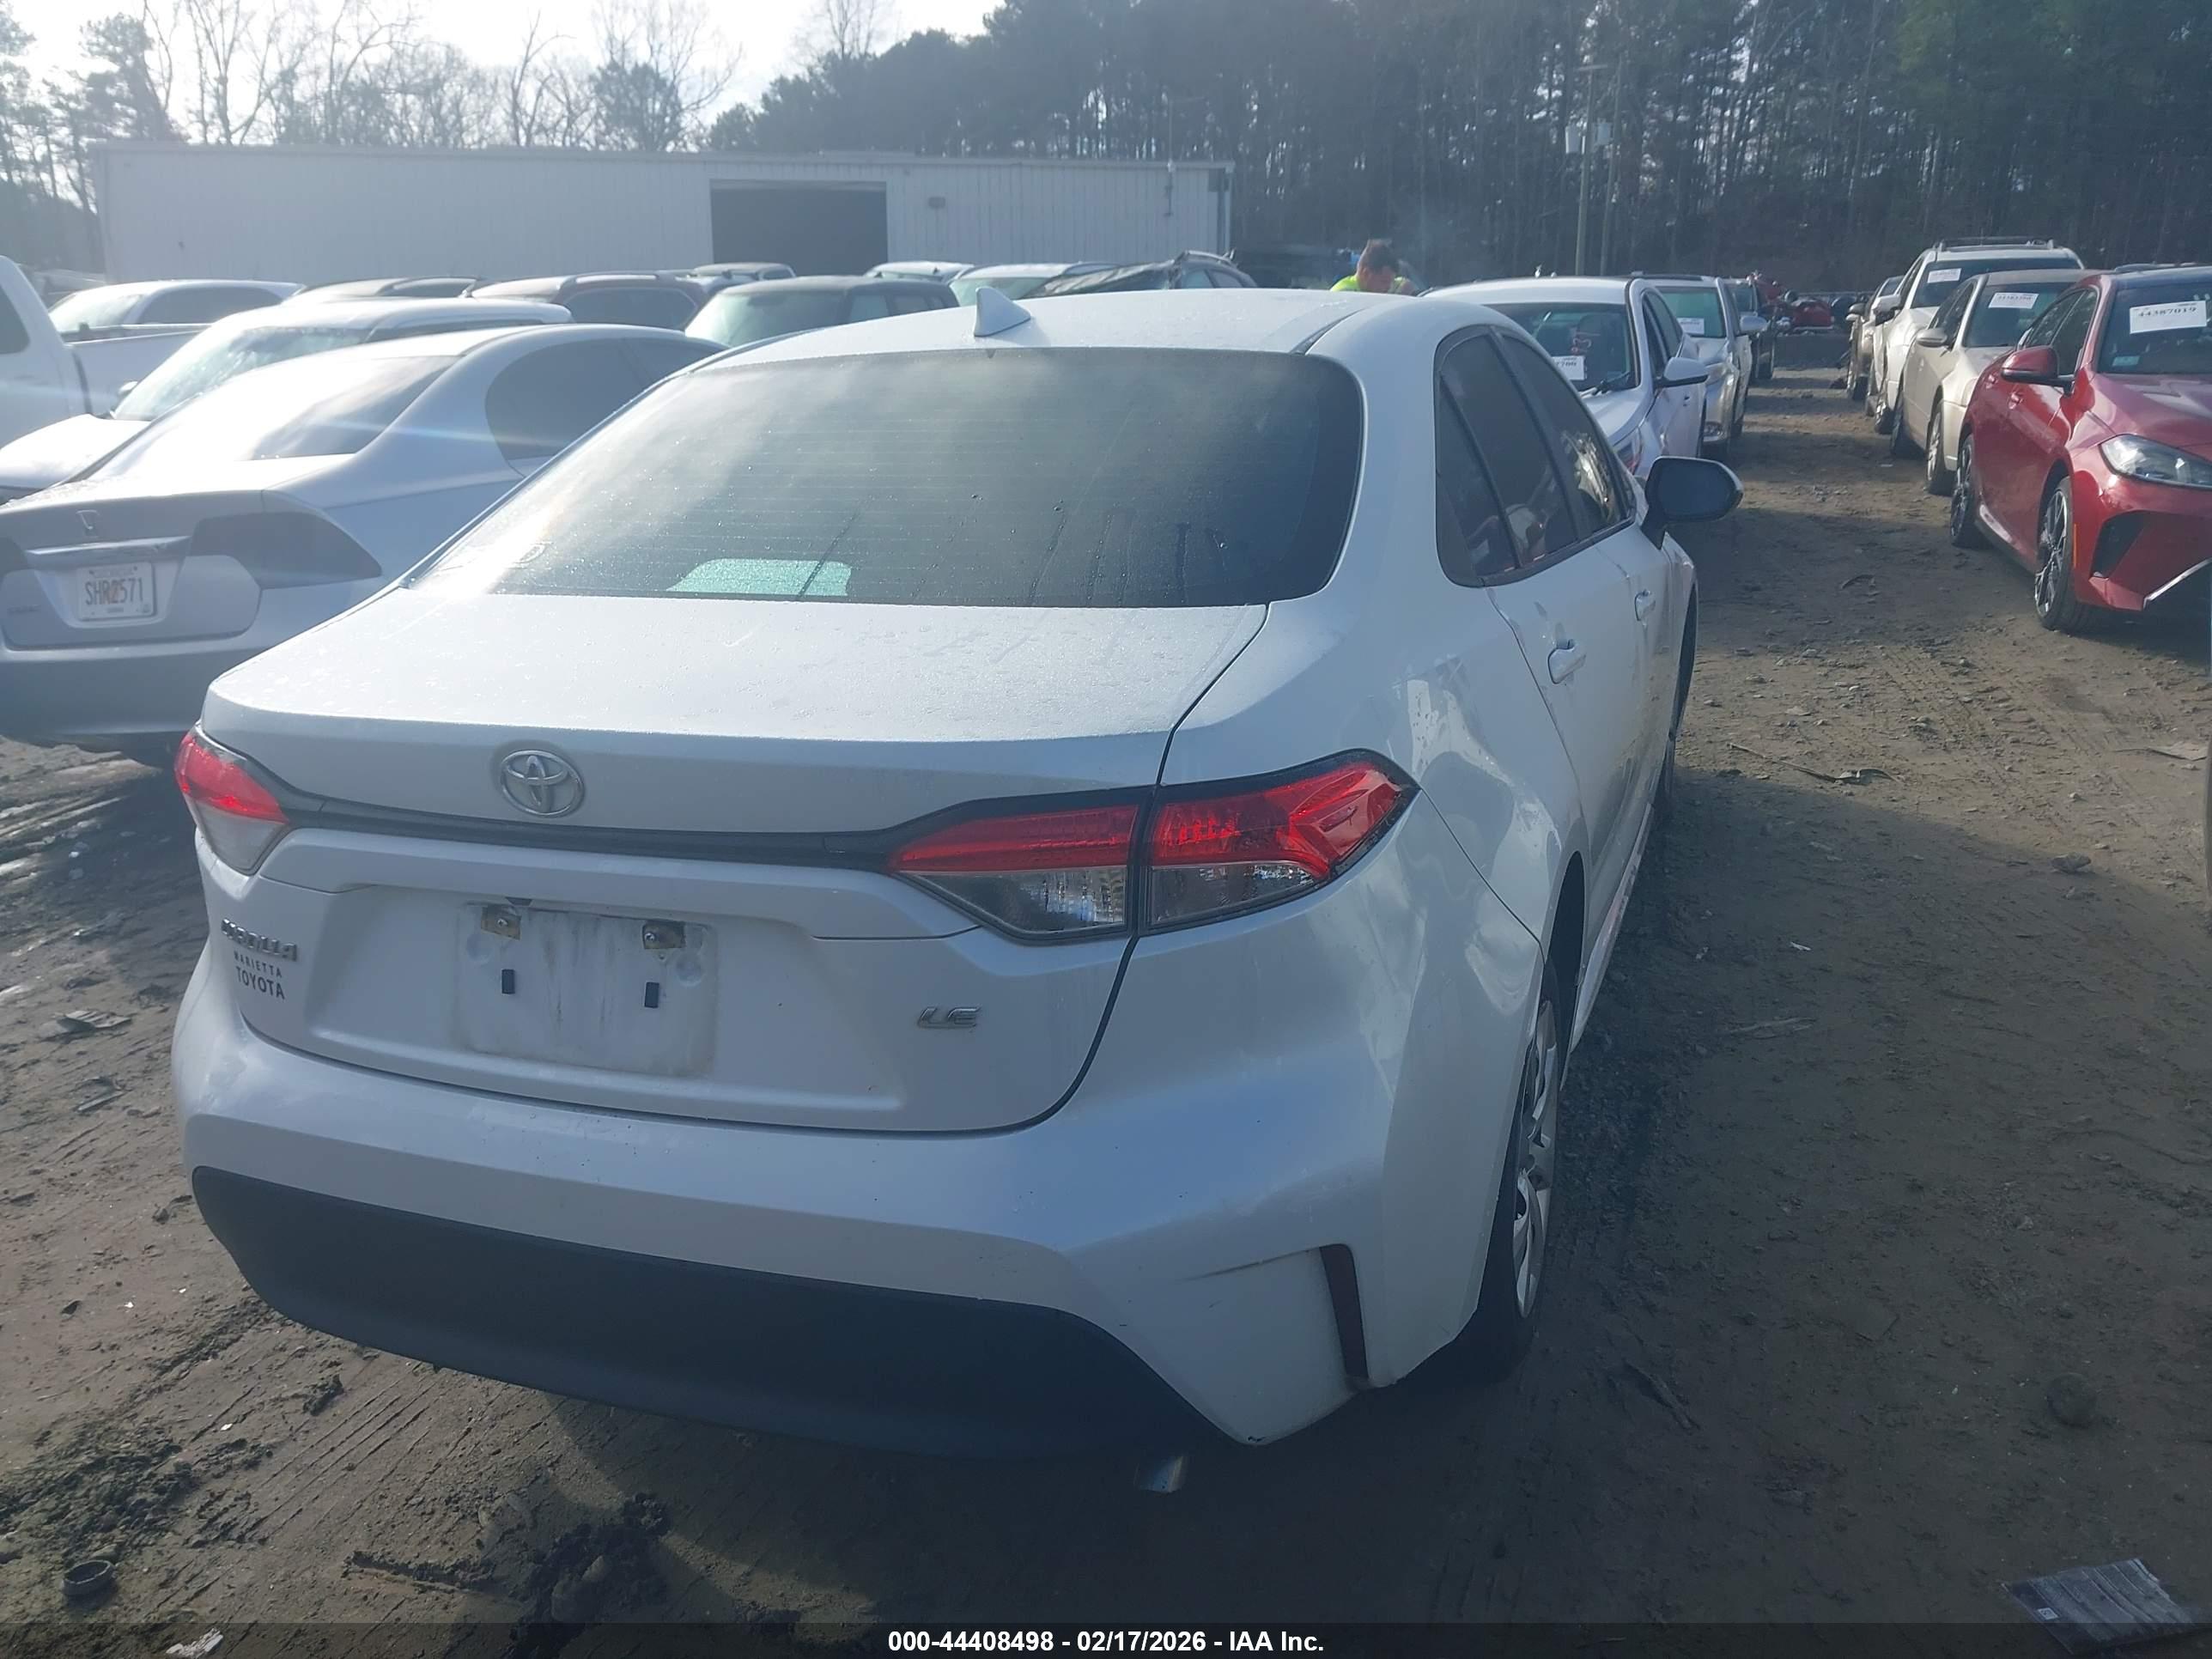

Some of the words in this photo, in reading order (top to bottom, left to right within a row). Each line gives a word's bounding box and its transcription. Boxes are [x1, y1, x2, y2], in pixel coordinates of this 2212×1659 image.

[234, 950, 283, 979] MARIETTA
[235, 966, 285, 1000] TOYOTA
[917, 1006, 980, 1030] LE
